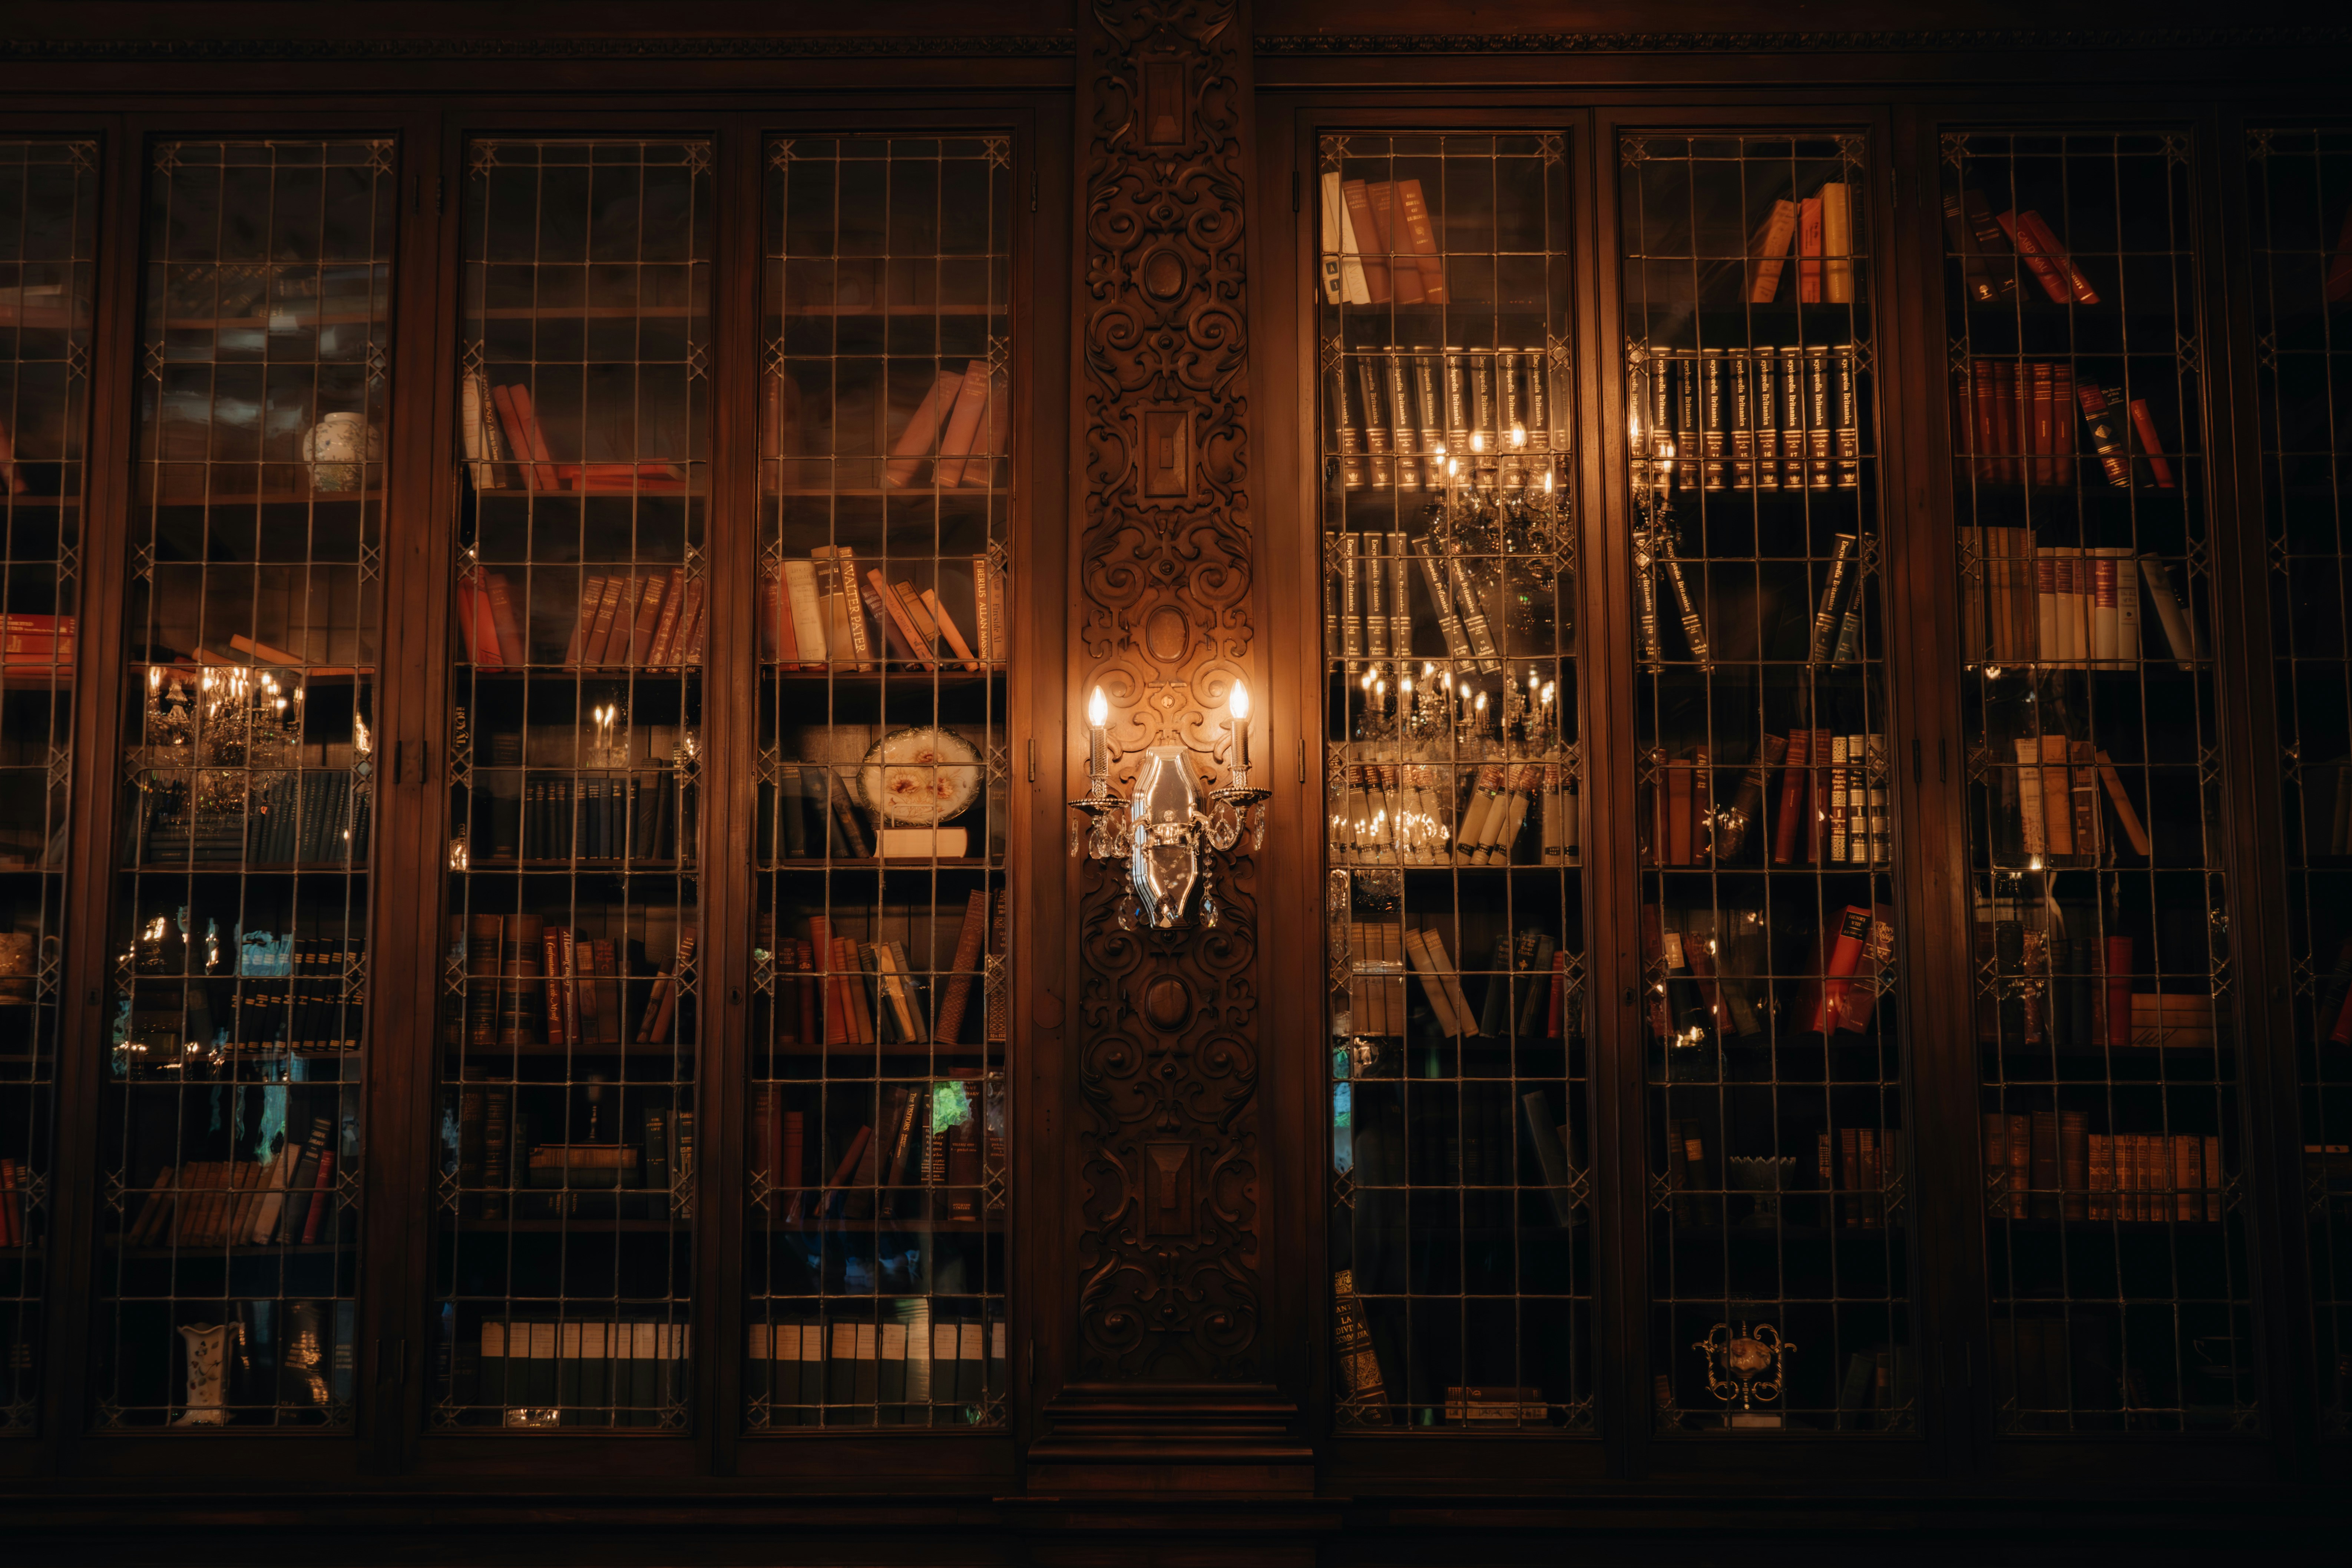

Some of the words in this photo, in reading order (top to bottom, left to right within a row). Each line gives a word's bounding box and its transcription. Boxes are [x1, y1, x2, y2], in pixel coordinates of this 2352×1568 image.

[1398, 393, 1407, 425] Britannica
[1453, 394, 1461, 426] Britannica
[1508, 395, 1516, 427] Britannica
[1815, 394, 1823, 426] Britannica
[1843, 393, 1852, 425] Britannica
[1347, 539, 1355, 578] Encycpædia
[1835, 540, 1849, 578] Encycpædia
[844, 564, 860, 614] WALTER
[977, 560, 986, 598] TIBERIUS
[1422, 543, 1438, 581] Enclopædia
[1435, 582, 1449, 613] Britannica
[1667, 541, 1682, 580] Encycpædia
[1677, 580, 1690, 612] Britannica
[1461, 582, 1475, 613] Britannica
[1643, 580, 1652, 611] Britannica
[1828, 580, 1840, 611] Britannica
[979, 602, 988, 629] ALLAN
[993, 604, 1001, 632] Fireside
[851, 615, 866, 653] PATER
[1836, 808, 1842, 818] 1
[1856, 806, 1862, 816] 1
[1849, 914, 1866, 922] HENRY
[546, 942, 555, 982] Confrontatios
[550, 998, 559, 1022] Myself
[903, 1104, 914, 1131] VISITORS
[1336, 1304, 1352, 1313] ANT
[1341, 1316, 1352, 1324] LA
[1336, 1322, 1363, 1335] DIVIA
